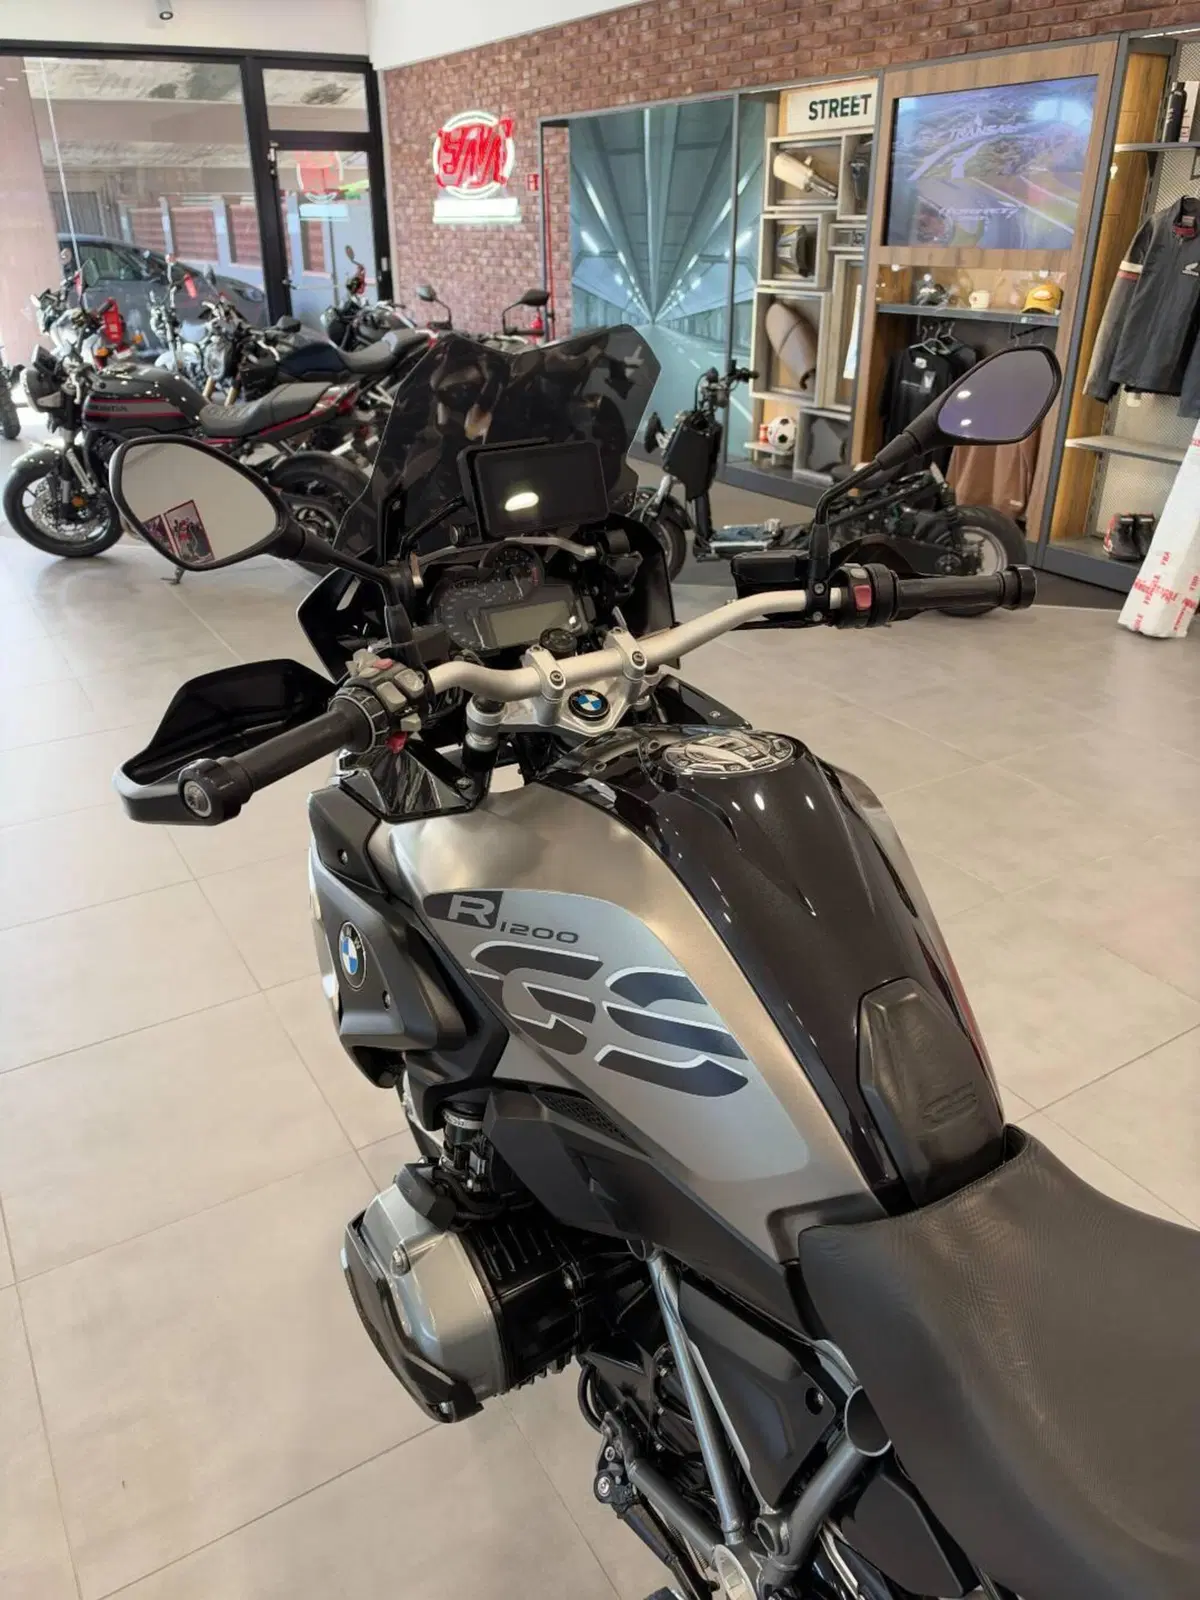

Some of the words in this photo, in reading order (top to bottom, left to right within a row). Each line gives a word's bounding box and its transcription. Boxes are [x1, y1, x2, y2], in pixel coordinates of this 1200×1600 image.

[808, 94, 872, 121] STREET
[447, 894, 495, 927] R
[500, 921, 579, 944] 1200
